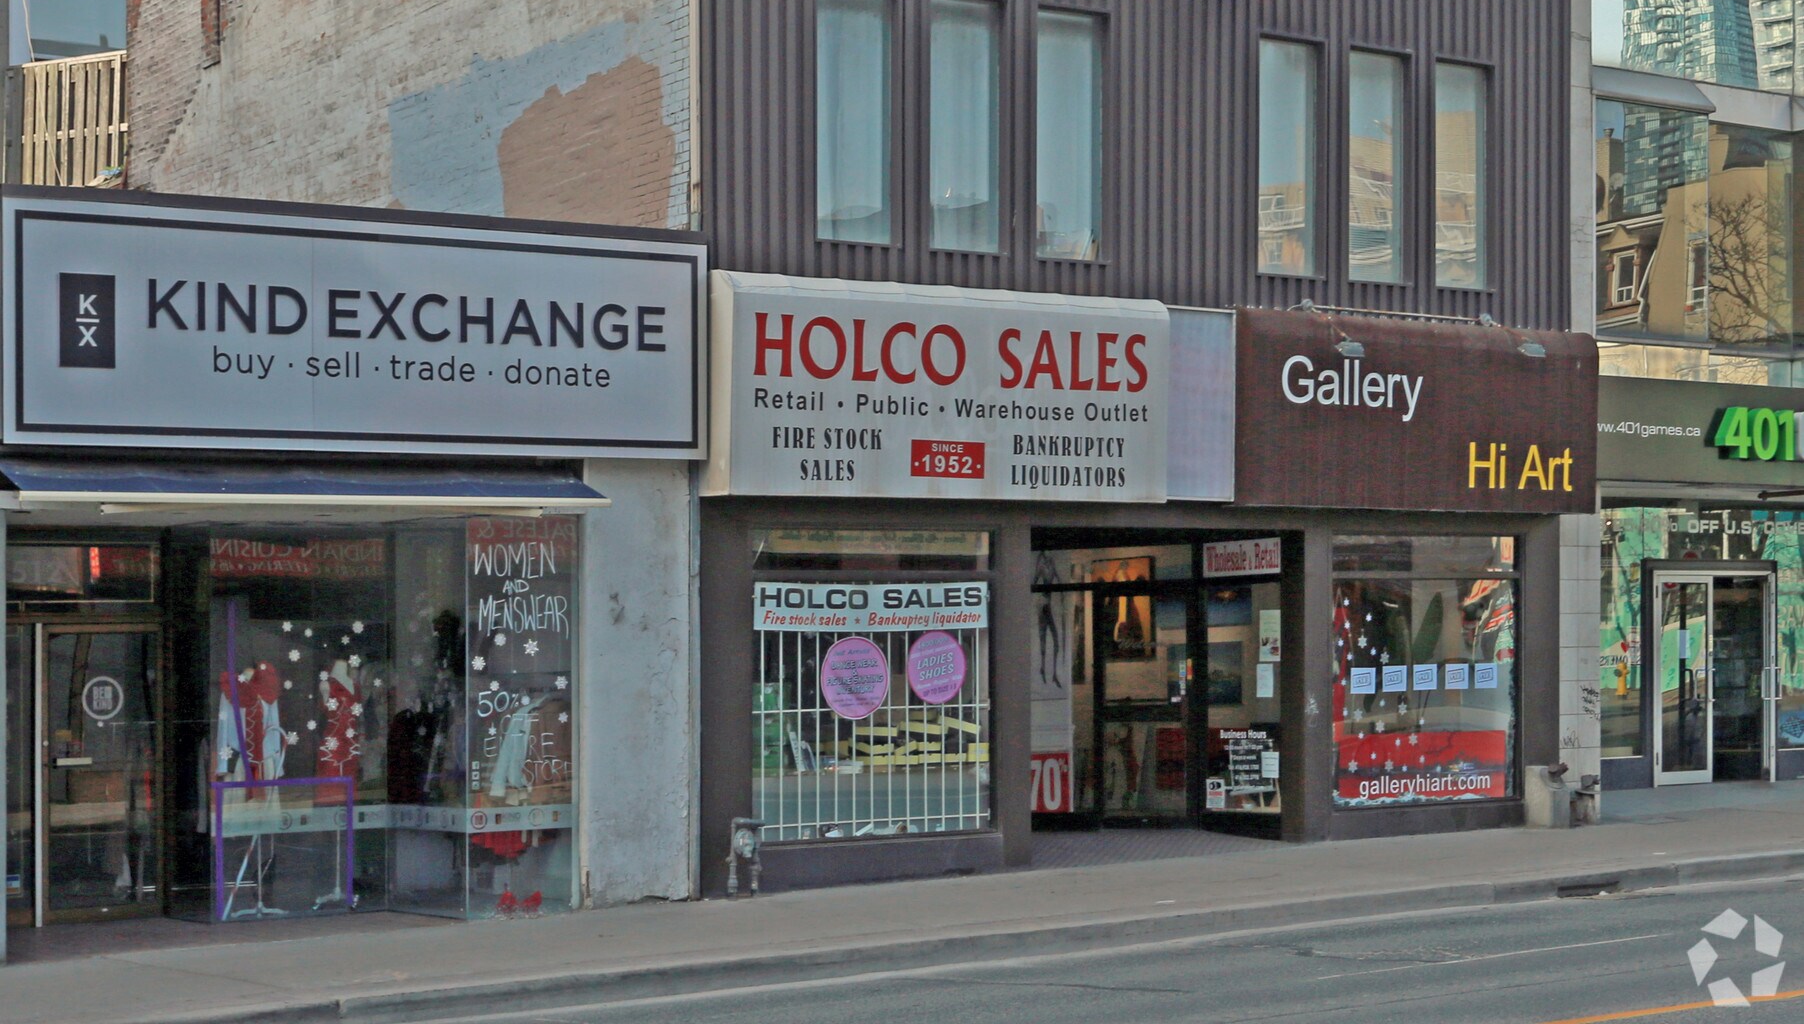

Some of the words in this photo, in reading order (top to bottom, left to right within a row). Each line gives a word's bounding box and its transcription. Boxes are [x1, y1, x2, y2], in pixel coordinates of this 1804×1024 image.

[78, 294, 98, 316] K
[147, 278, 308, 335] KIND
[328, 290, 666, 352] EXCHANGE
[77, 325, 99, 347] X
[754, 311, 967, 387] HOLCO
[998, 327, 1149, 393] SALES
[212, 346, 275, 380] buy
[305, 351, 361, 379] sell
[390, 354, 476, 383] trade
[504, 359, 611, 388] donate
[1281, 354, 1424, 422] Gallery
[753, 388, 825, 412] Retail
[855, 393, 929, 417] Public
[954, 398, 1075, 422] Warehouse
[1084, 402, 1149, 422] Outlet
[772, 426, 816, 449] FIRE
[823, 427, 883, 451] STOCK
[1714, 406, 1796, 462] 401
[931, 442, 964, 454] SINCE
[1013, 434, 1125, 459] BANKRUPTCY
[799, 459, 856, 482] SALES
[920, 453, 973, 475] 1952
[1467, 442, 1506, 490] Hi
[1517, 445, 1574, 493] Art
[1010, 465, 1127, 488] LIQUIDATORS
[1687, 519, 1720, 534] OFF
[474, 541, 556, 579] WOMEN
[1254, 542, 1279, 570] Retail
[502, 579, 530, 596] AND
[759, 587, 869, 609] HOLCO
[883, 586, 983, 609] SALES
[478, 594, 569, 640] MENSWEAR
[763, 609, 787, 625] Fire
[788, 611, 817, 626] stock
[819, 611, 847, 626] sales
[868, 610, 930, 628] Bankruptcy
[931, 610, 982, 626] liquidator
[917, 652, 954, 670] LADIES
[919, 663, 955, 681] SHOES
[477, 691, 519, 718] 50%
[1247, 729, 1267, 739] Hours
[522, 758, 573, 787] STORE
[1359, 774, 1491, 797] galleryhiart.com
